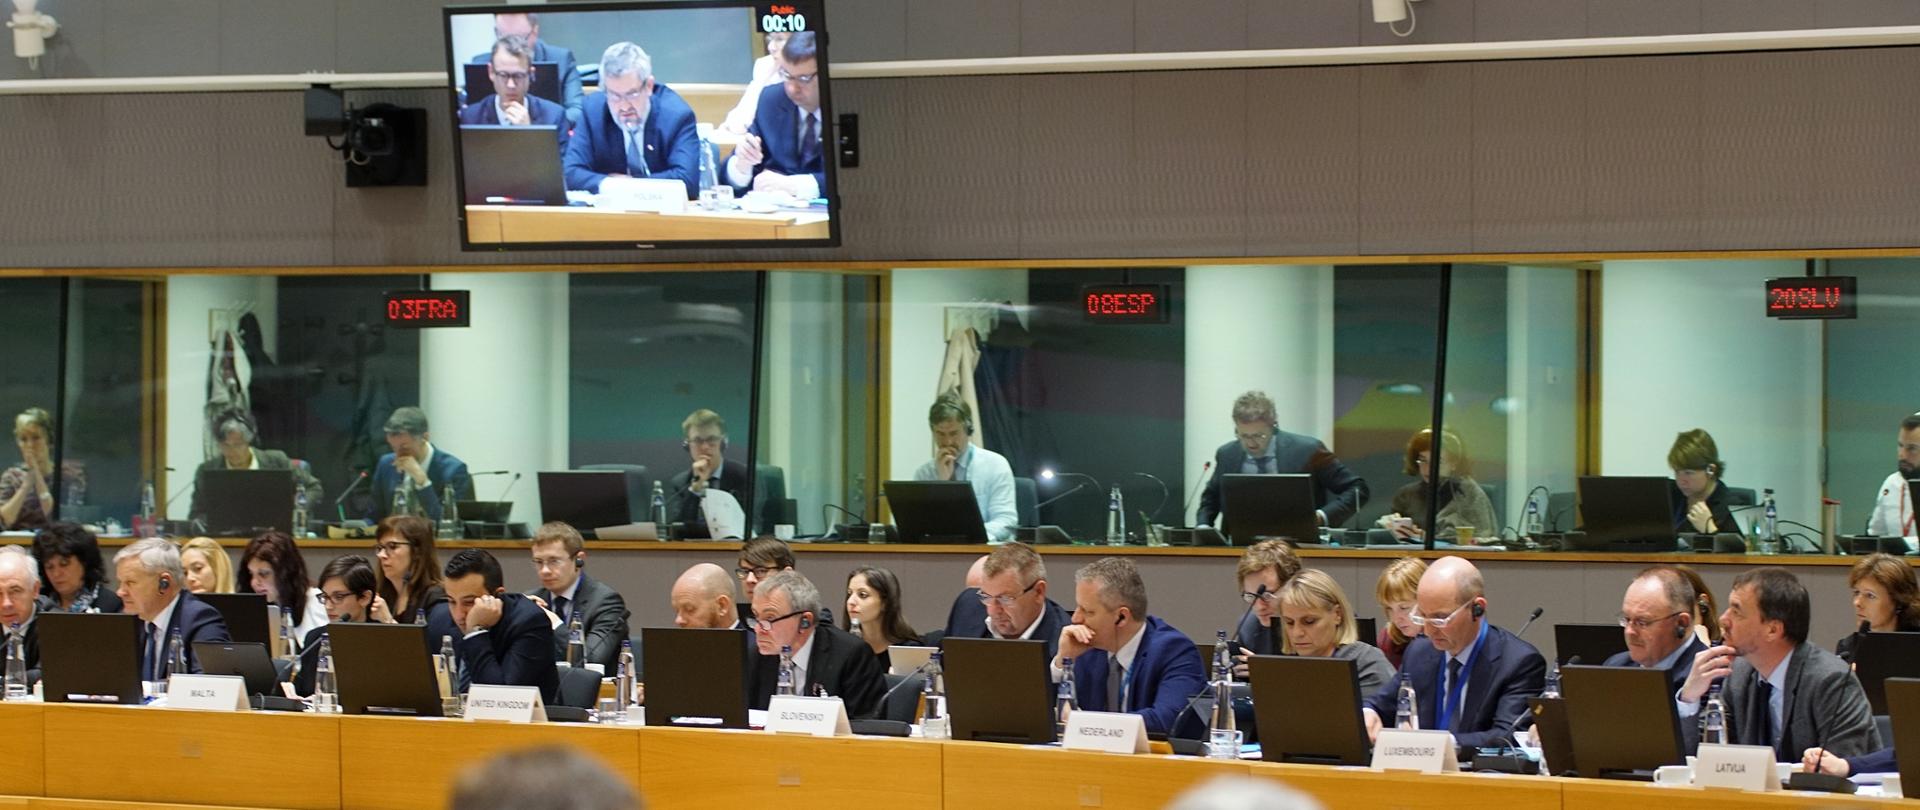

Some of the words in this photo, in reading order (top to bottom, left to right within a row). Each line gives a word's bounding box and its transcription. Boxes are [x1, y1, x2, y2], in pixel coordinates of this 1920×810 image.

[770, 5, 796, 14] Public
[762, 14, 806, 32] 00:10
[1771, 287, 1840, 309] 20SLV
[387, 299, 457, 319] 03FRA
[1087, 294, 1156, 314] 08ESP
[190, 689, 216, 697] MALTA
[470, 699, 496, 708] UNITED
[496, 701, 529, 710] KINGDOM
[780, 711, 824, 722] SLOVENSKO
[1079, 727, 1124, 738] NEDERLAND
[1383, 746, 1435, 757] LUXEMBOURG
